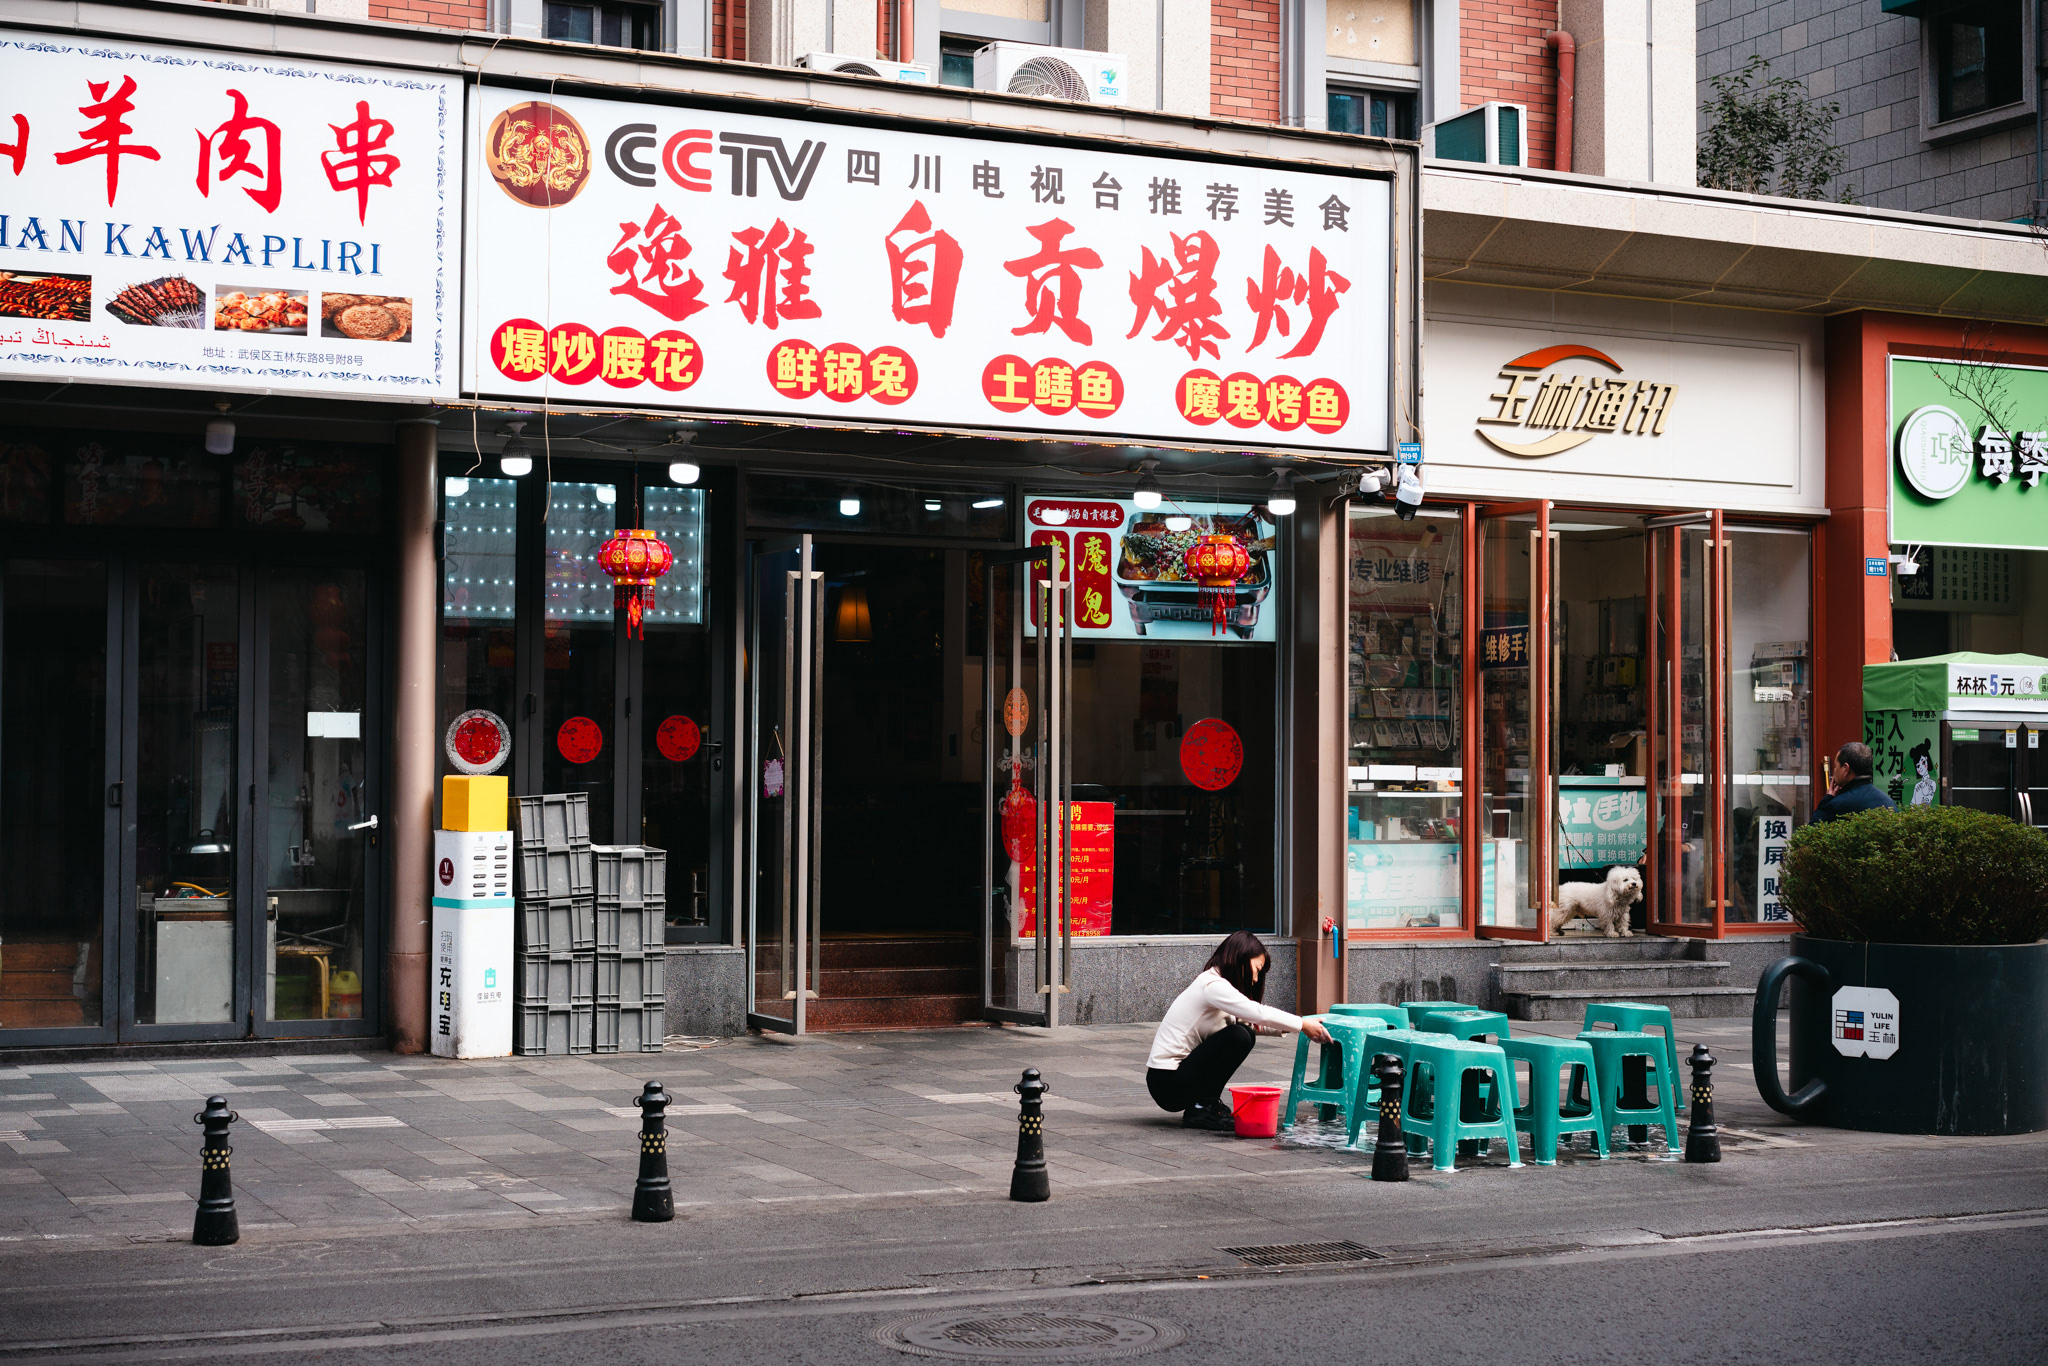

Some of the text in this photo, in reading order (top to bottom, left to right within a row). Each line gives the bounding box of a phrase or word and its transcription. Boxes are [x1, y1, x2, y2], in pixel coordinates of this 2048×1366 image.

[605, 123, 1351, 233] CCTV 四川电视台推荐美食
[104, 222, 384, 277] KAWAPLIRI
[607, 199, 1352, 361] 逸雅自贡爆炒
[500, 326, 694, 384] 爆炒腰花
[776, 346, 909, 398] 鲜锅兔
[991, 362, 1116, 411] 土鳝鱼
[1183, 376, 1342, 427] 魔鬼烤鱼
[1477, 370, 1679, 436] 玉林通讯
[1077, 536, 1110, 625] 魔鬼
[1956, 674, 2015, 696] 杯杯5元
[1598, 790, 1640, 821] 手机
[1597, 849, 1638, 862] 更换电池
[1763, 820, 1789, 922] 换屏贴膜
[438, 966, 452, 1036] 充电宝
[1871, 1011, 1894, 1020] YULIN
[1874, 1022, 1891, 1030] LIFE
[1868, 1031, 1896, 1044] 玉林
